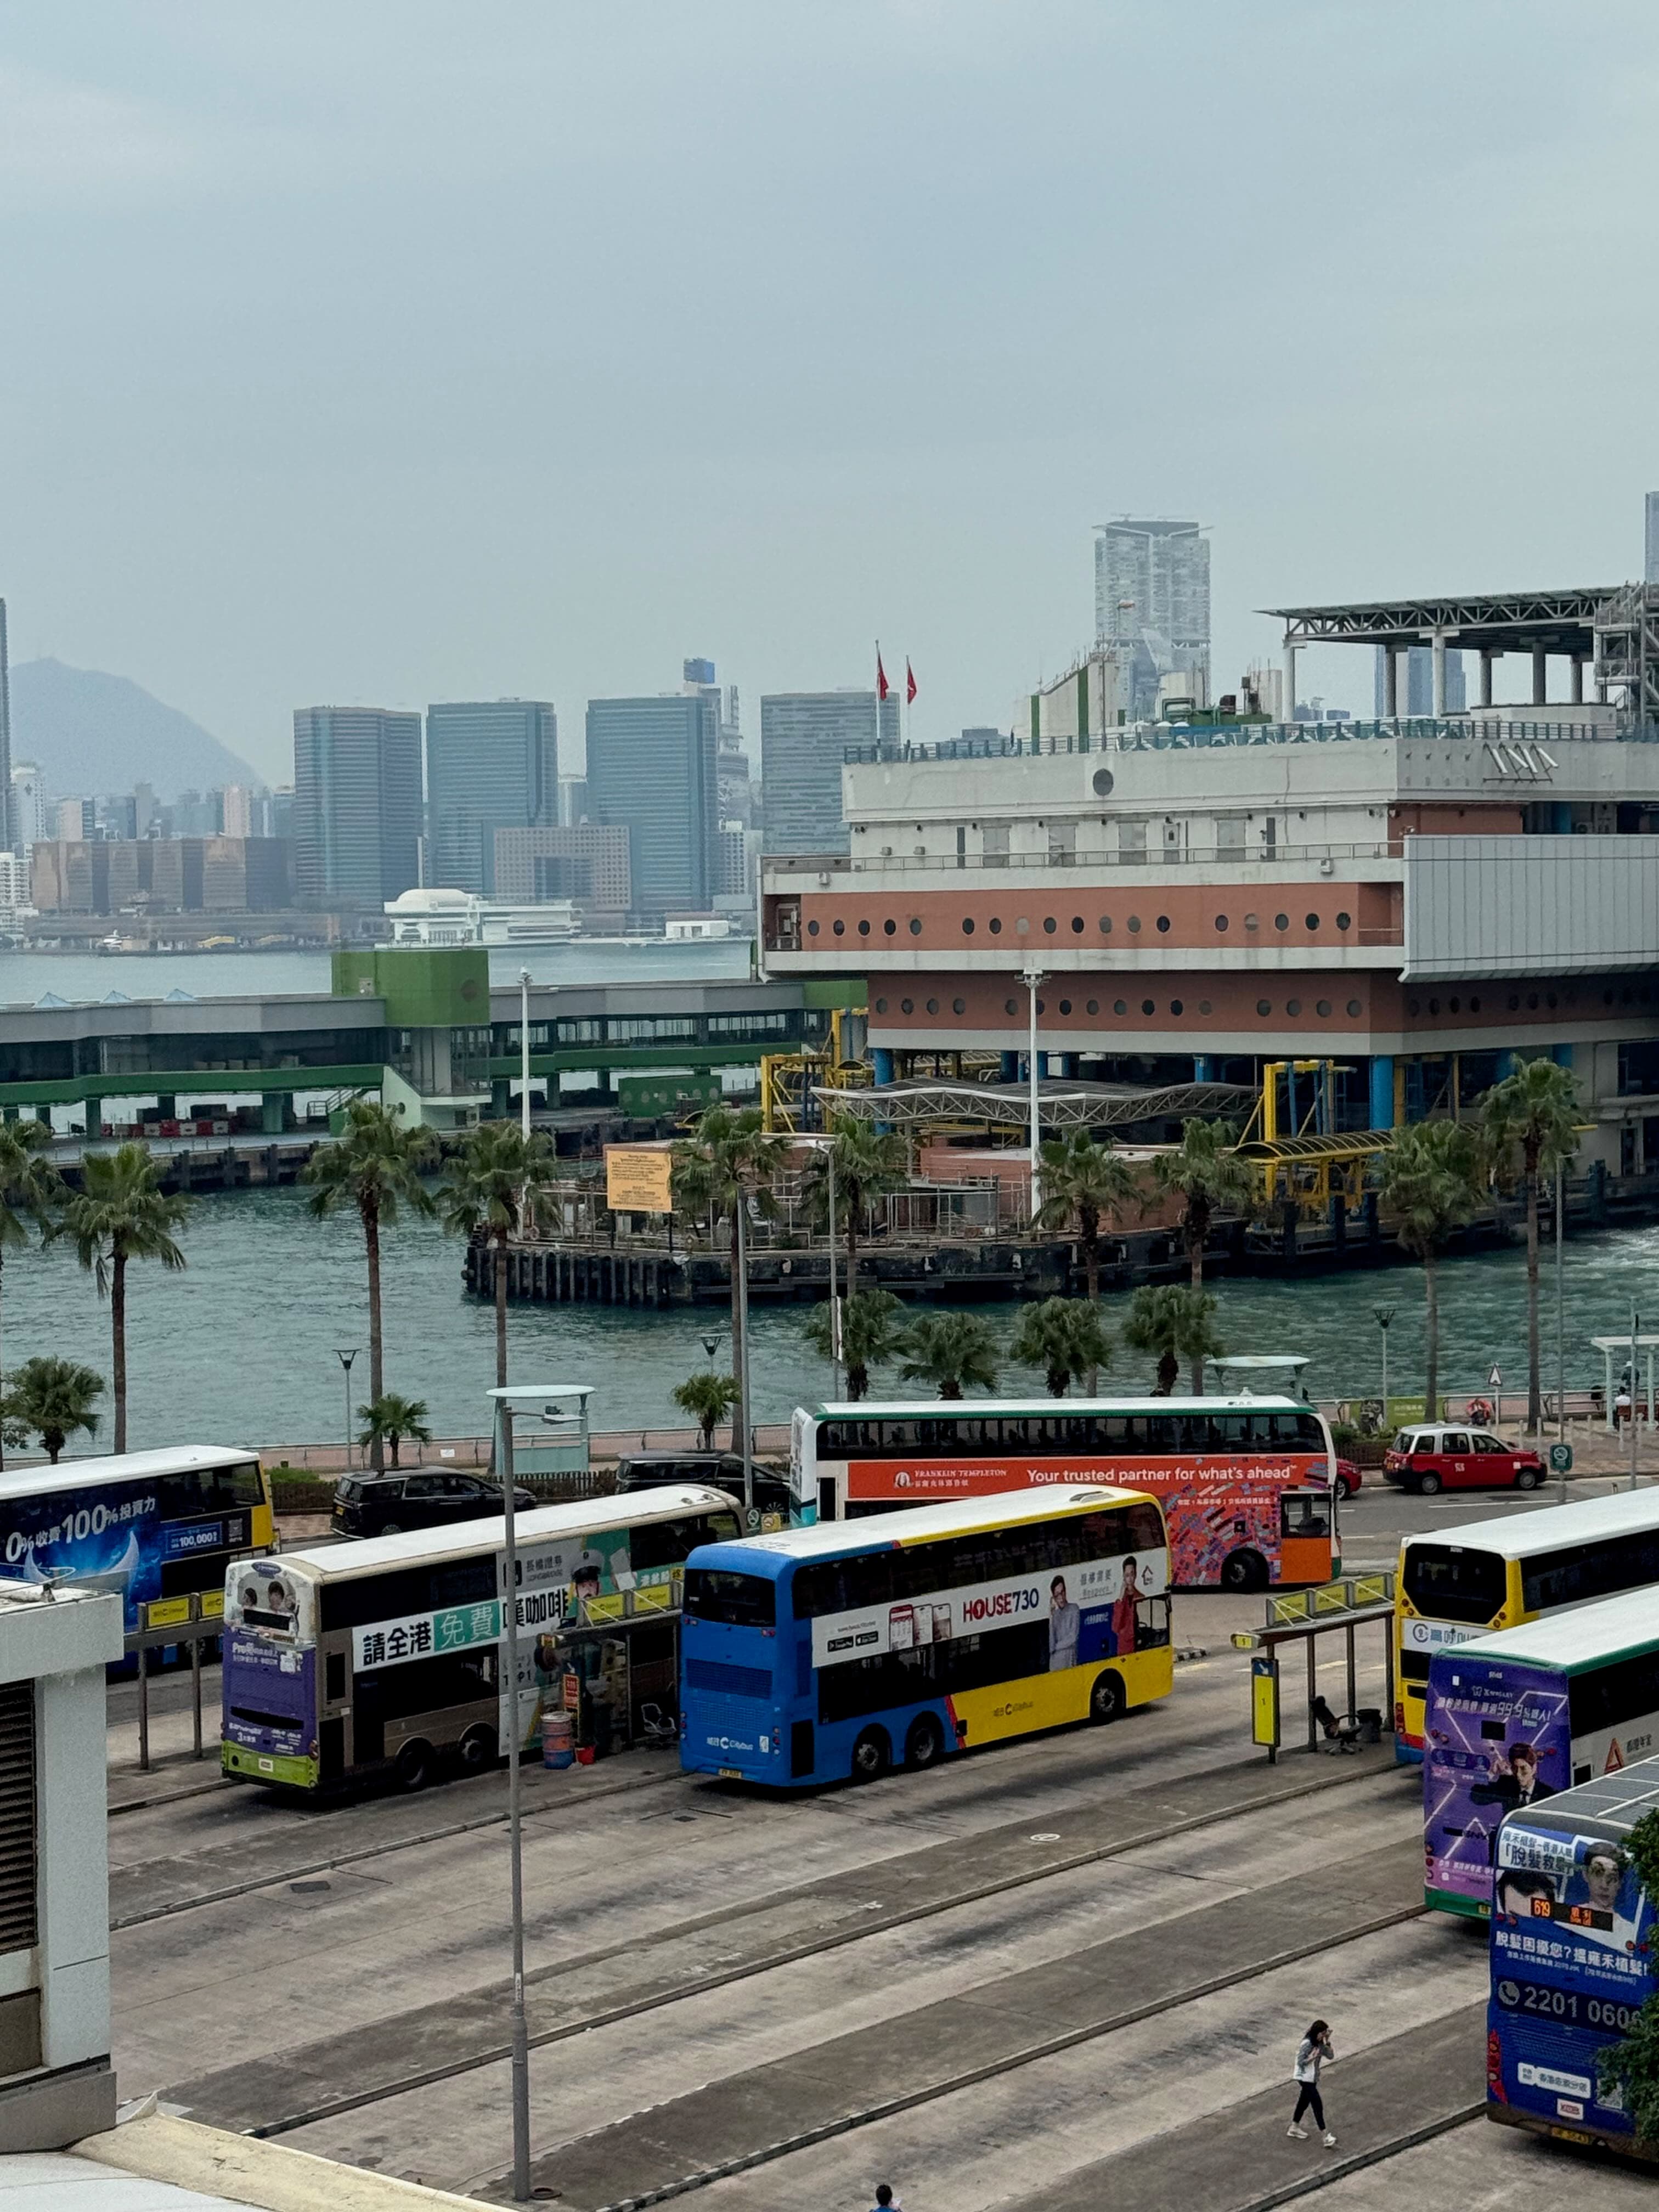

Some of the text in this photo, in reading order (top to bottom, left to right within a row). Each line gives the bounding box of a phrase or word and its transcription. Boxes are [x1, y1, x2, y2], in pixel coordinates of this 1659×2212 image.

[1027, 1470, 1059, 1482] Your
[1063, 1469, 1114, 1481] trusted
[1118, 1469, 1171, 1484] partner
[1175, 1467, 1195, 1480] for
[1199, 1467, 1243, 1480] what's
[963, 1588, 1039, 1623] HOUSE730
[1534, 1900, 1550, 1917] 619
[1523, 1986, 1578, 2018] 2201
